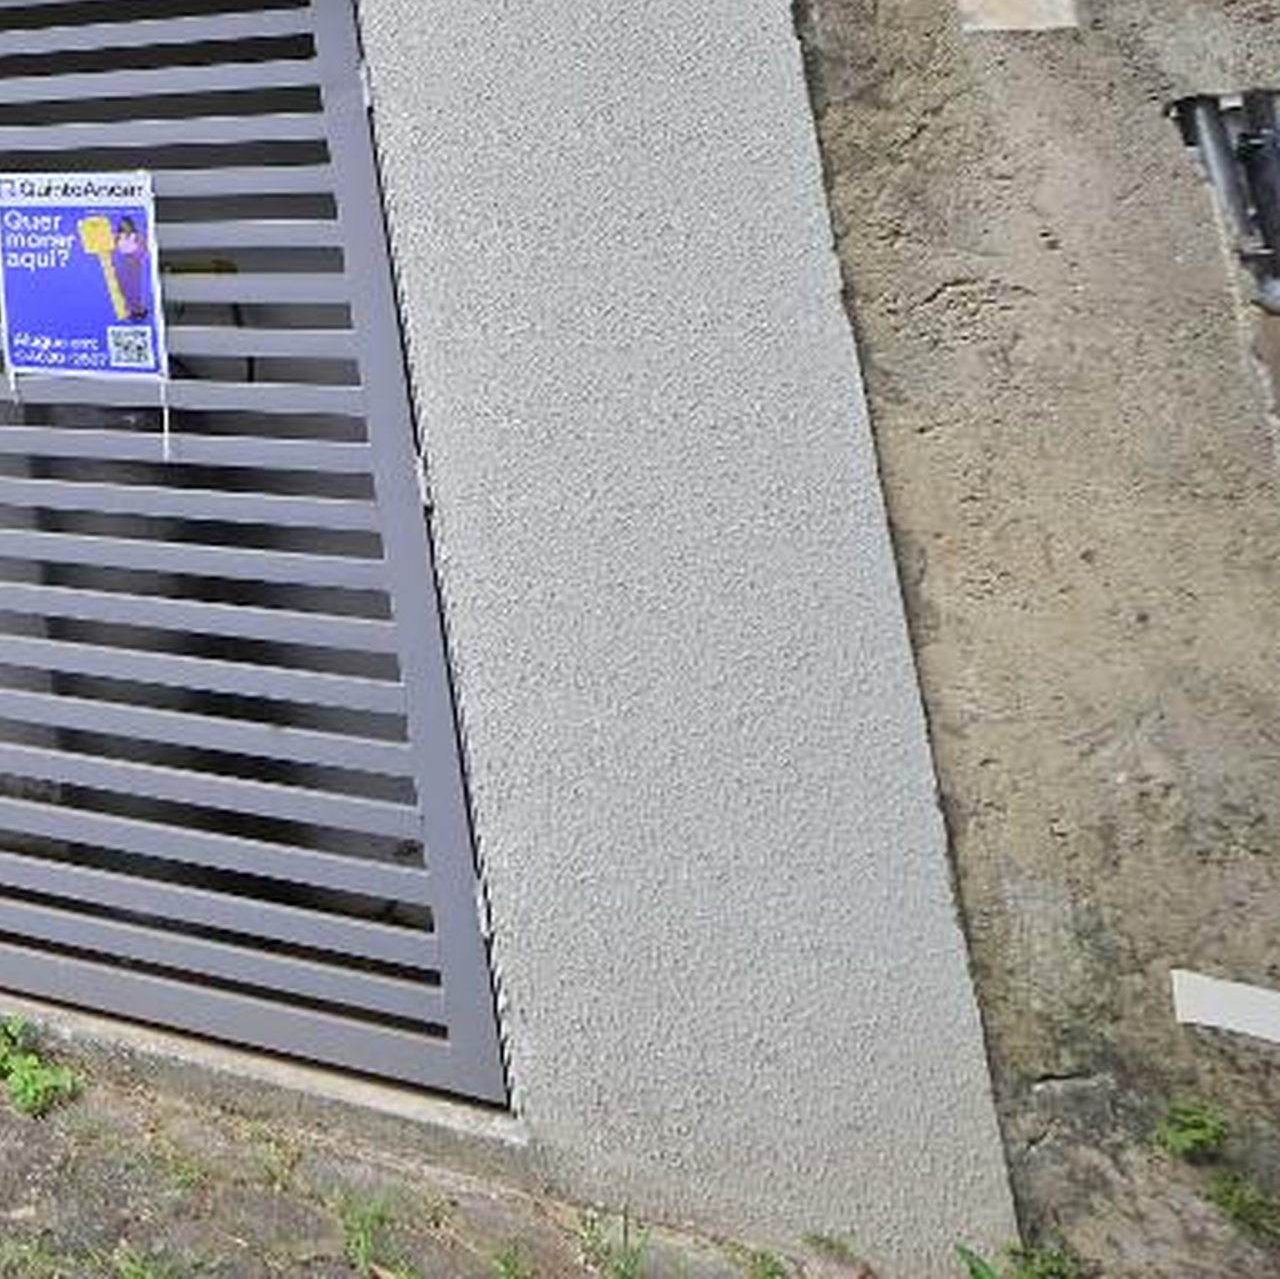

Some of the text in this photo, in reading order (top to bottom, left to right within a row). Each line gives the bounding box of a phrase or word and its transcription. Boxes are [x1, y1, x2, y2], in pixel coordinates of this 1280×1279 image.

[4, 210, 62, 231] Quer
[5, 232, 77, 249] morar
[6, 250, 70, 272] aqui?
